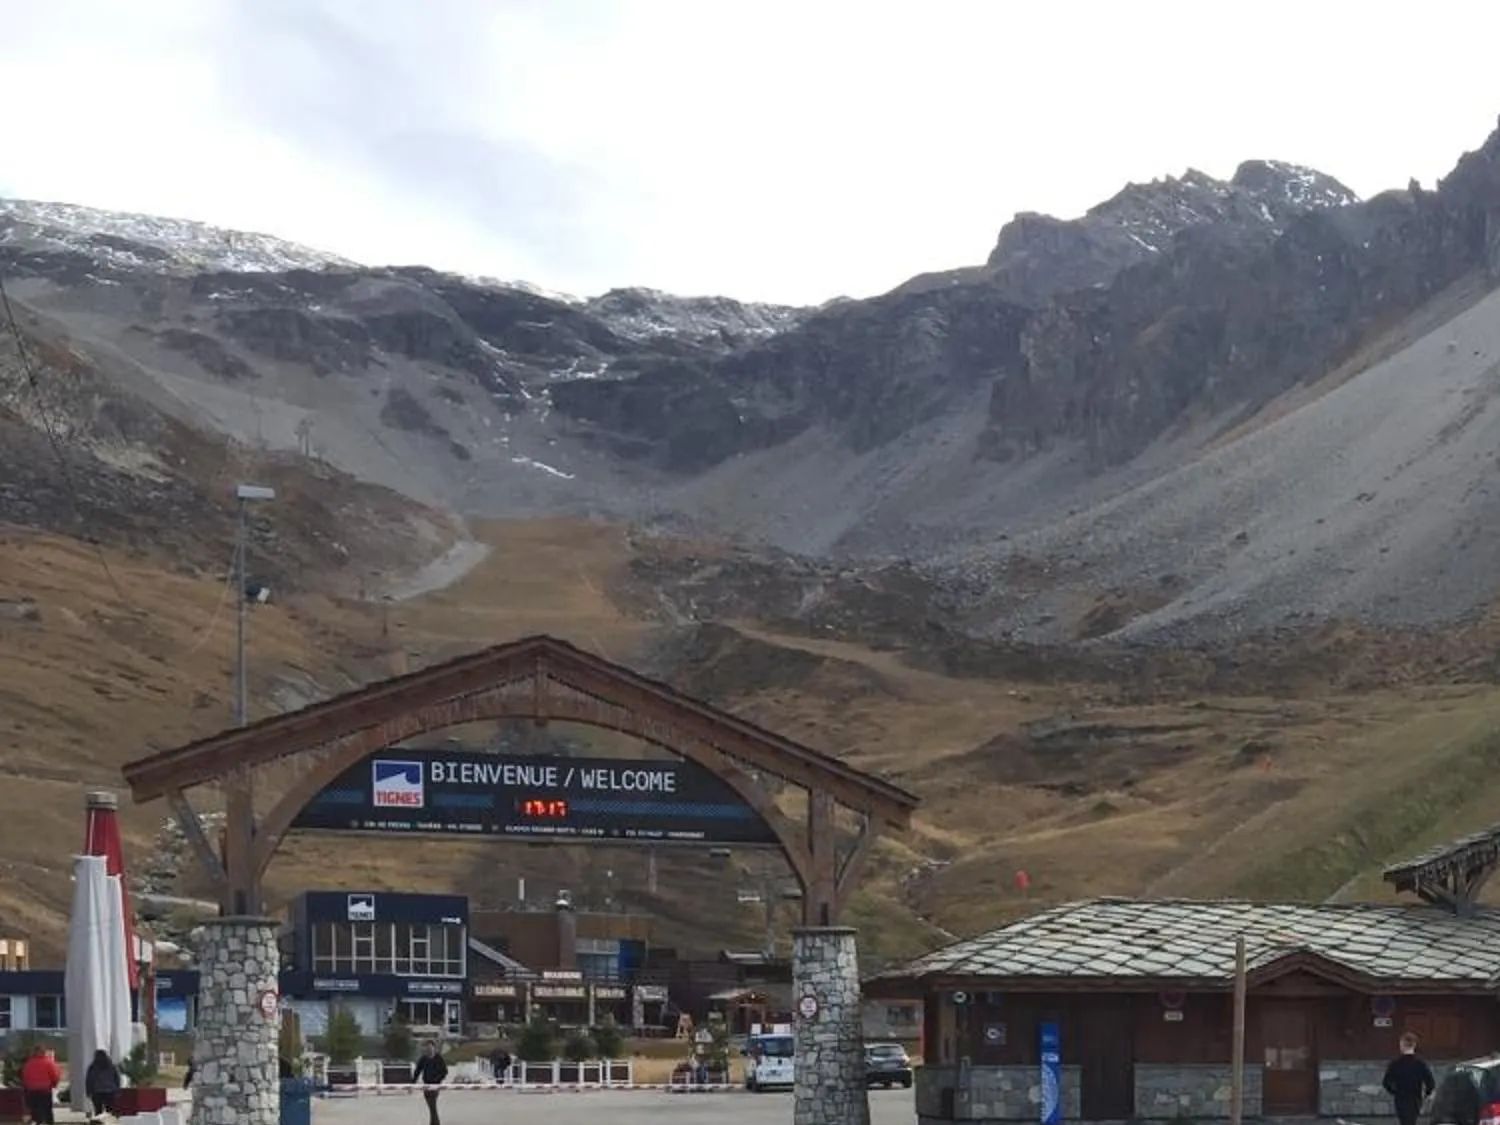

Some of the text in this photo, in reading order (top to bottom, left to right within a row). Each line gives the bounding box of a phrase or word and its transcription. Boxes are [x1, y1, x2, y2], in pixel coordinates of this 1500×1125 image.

[431, 761, 558, 787] BIENVENUE
[580, 768, 676, 792] WELCOME
[376, 791, 422, 805] TIGNES
